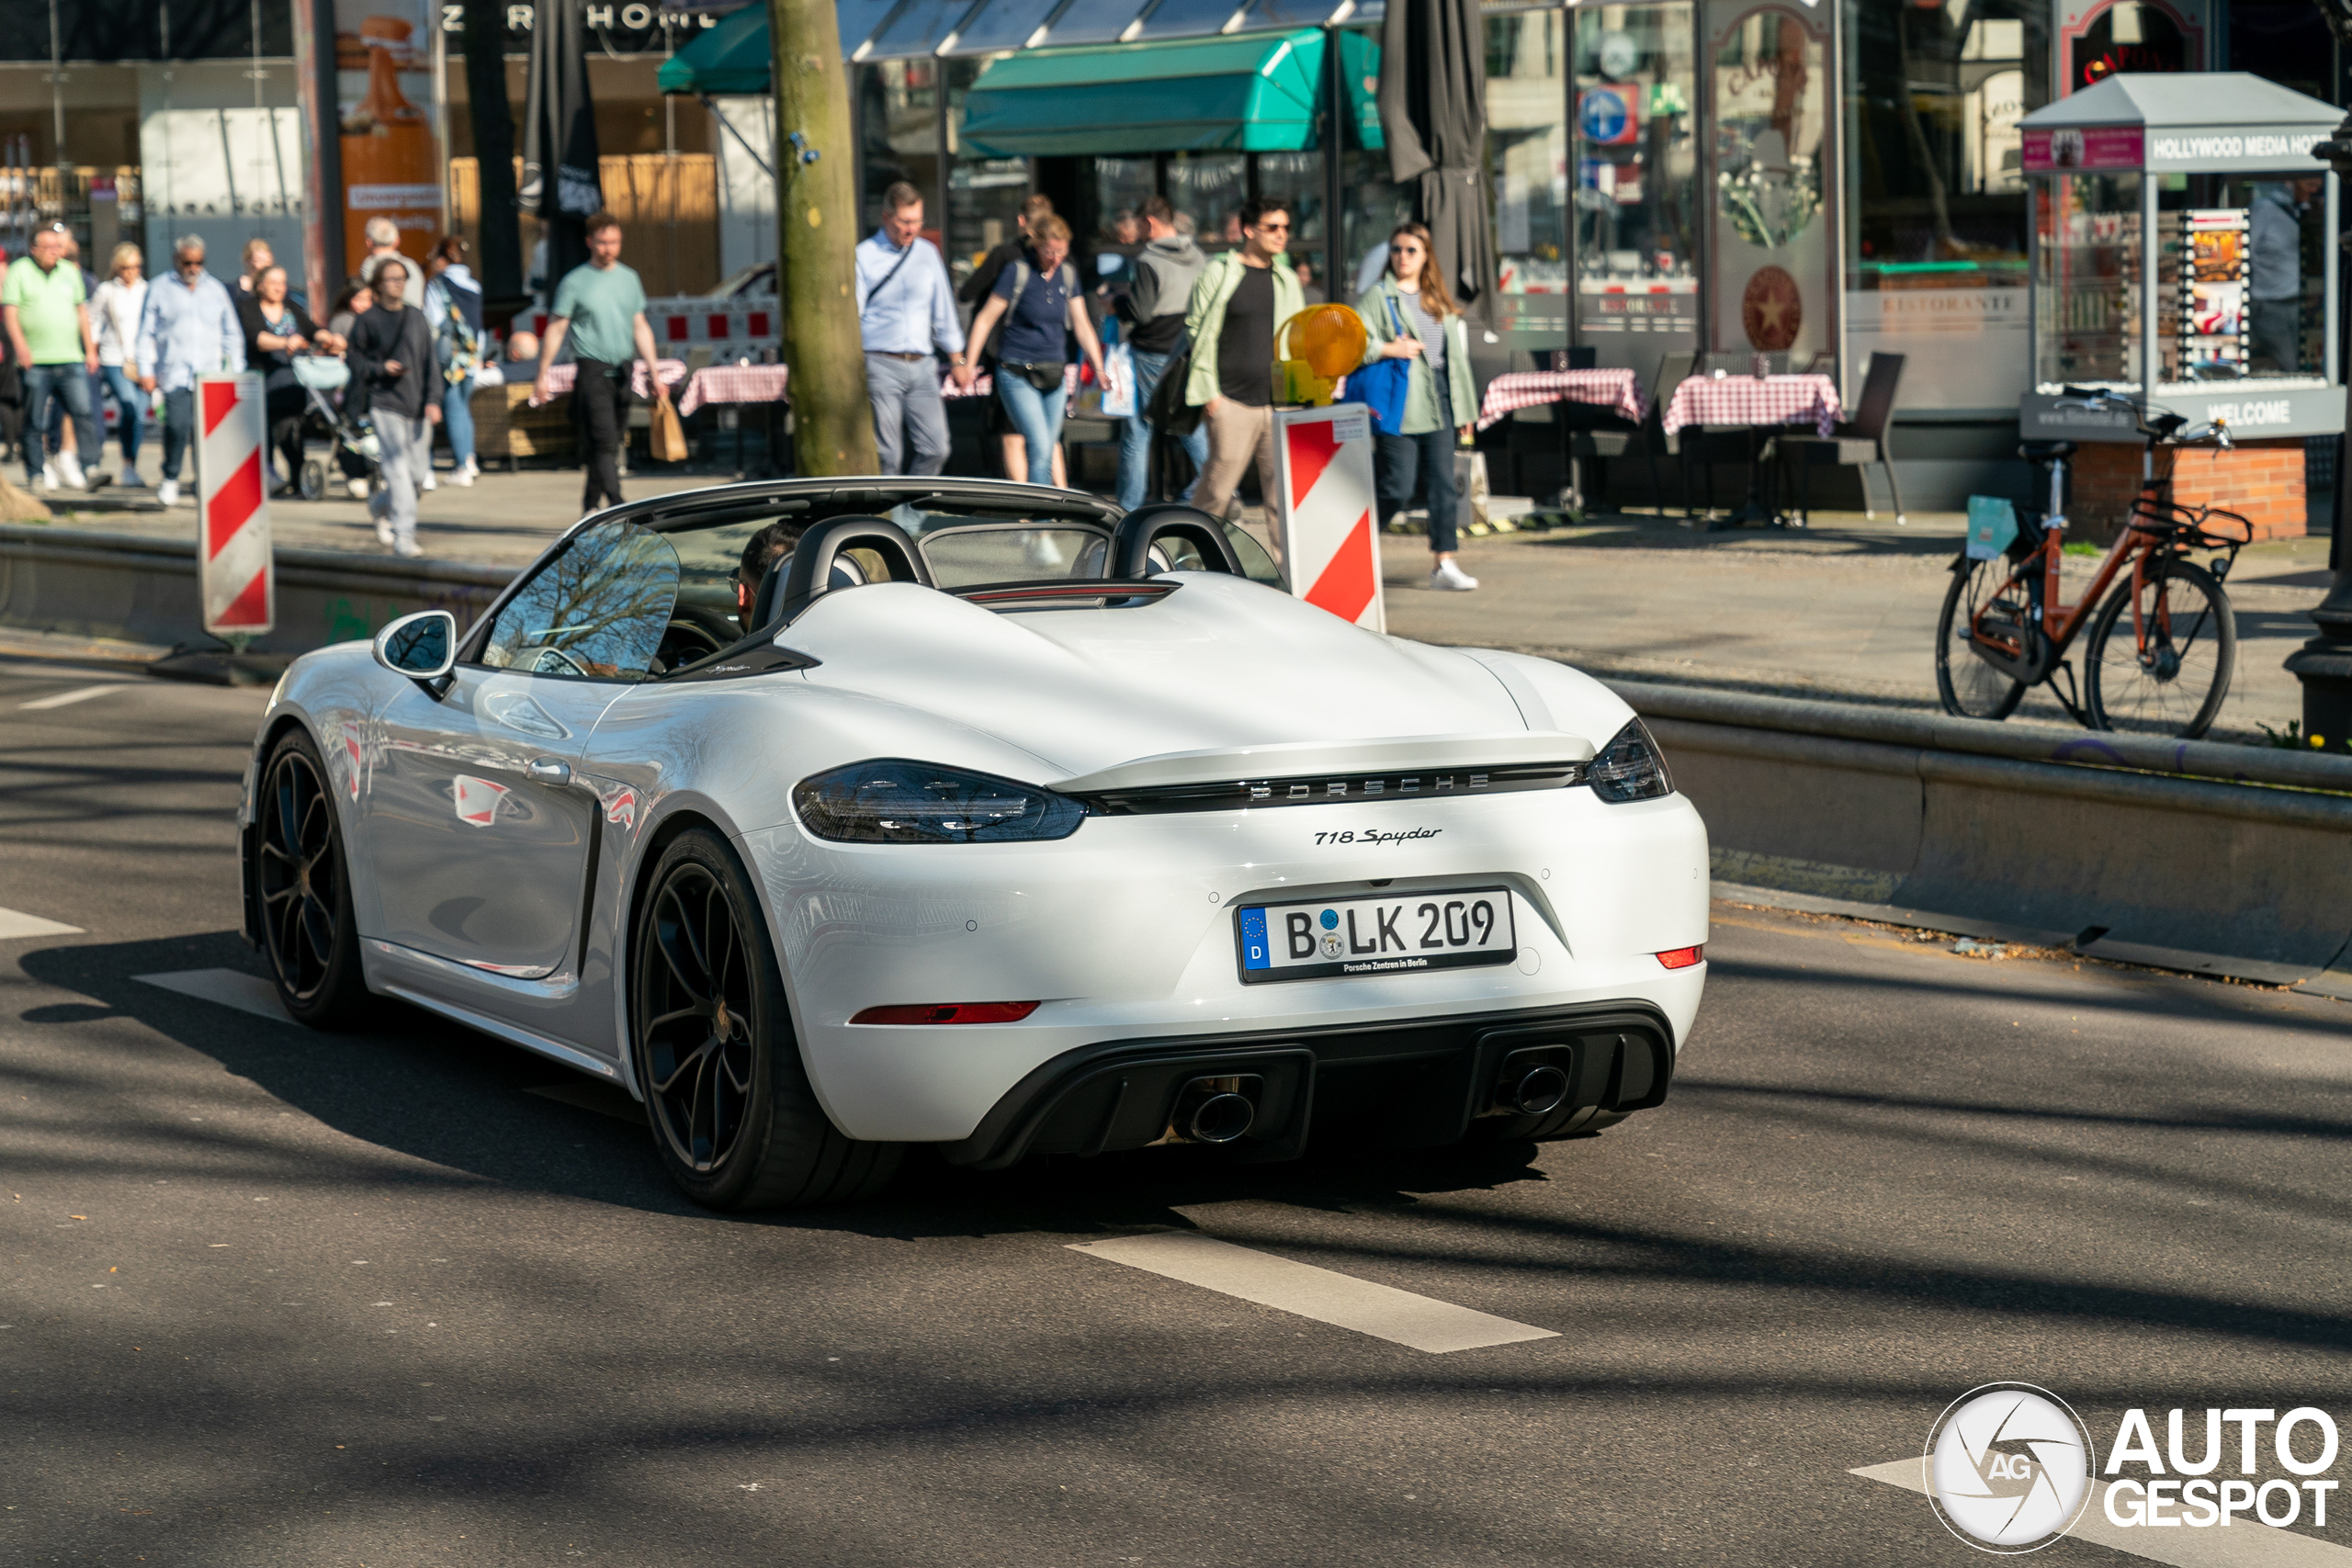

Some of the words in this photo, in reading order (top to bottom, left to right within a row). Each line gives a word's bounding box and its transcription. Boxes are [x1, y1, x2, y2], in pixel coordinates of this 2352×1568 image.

[2154, 136, 2243, 159] HOLLYWOOD
[2245, 135, 2290, 156] MEDIA
[2207, 400, 2290, 426] WELCOME
[1248, 773, 1488, 802] PORSCHE
[1314, 831, 1355, 846] 718
[1355, 827, 1443, 846] Spyder
[1285, 911, 1317, 959] B
[1346, 905, 1407, 954] LK
[1418, 899, 1495, 949] 209
[1250, 945, 1262, 960] D
[1343, 962, 1372, 973] Porsche
[1372, 961, 1398, 971] Zentren
[1408, 958, 1428, 967] Berlin
